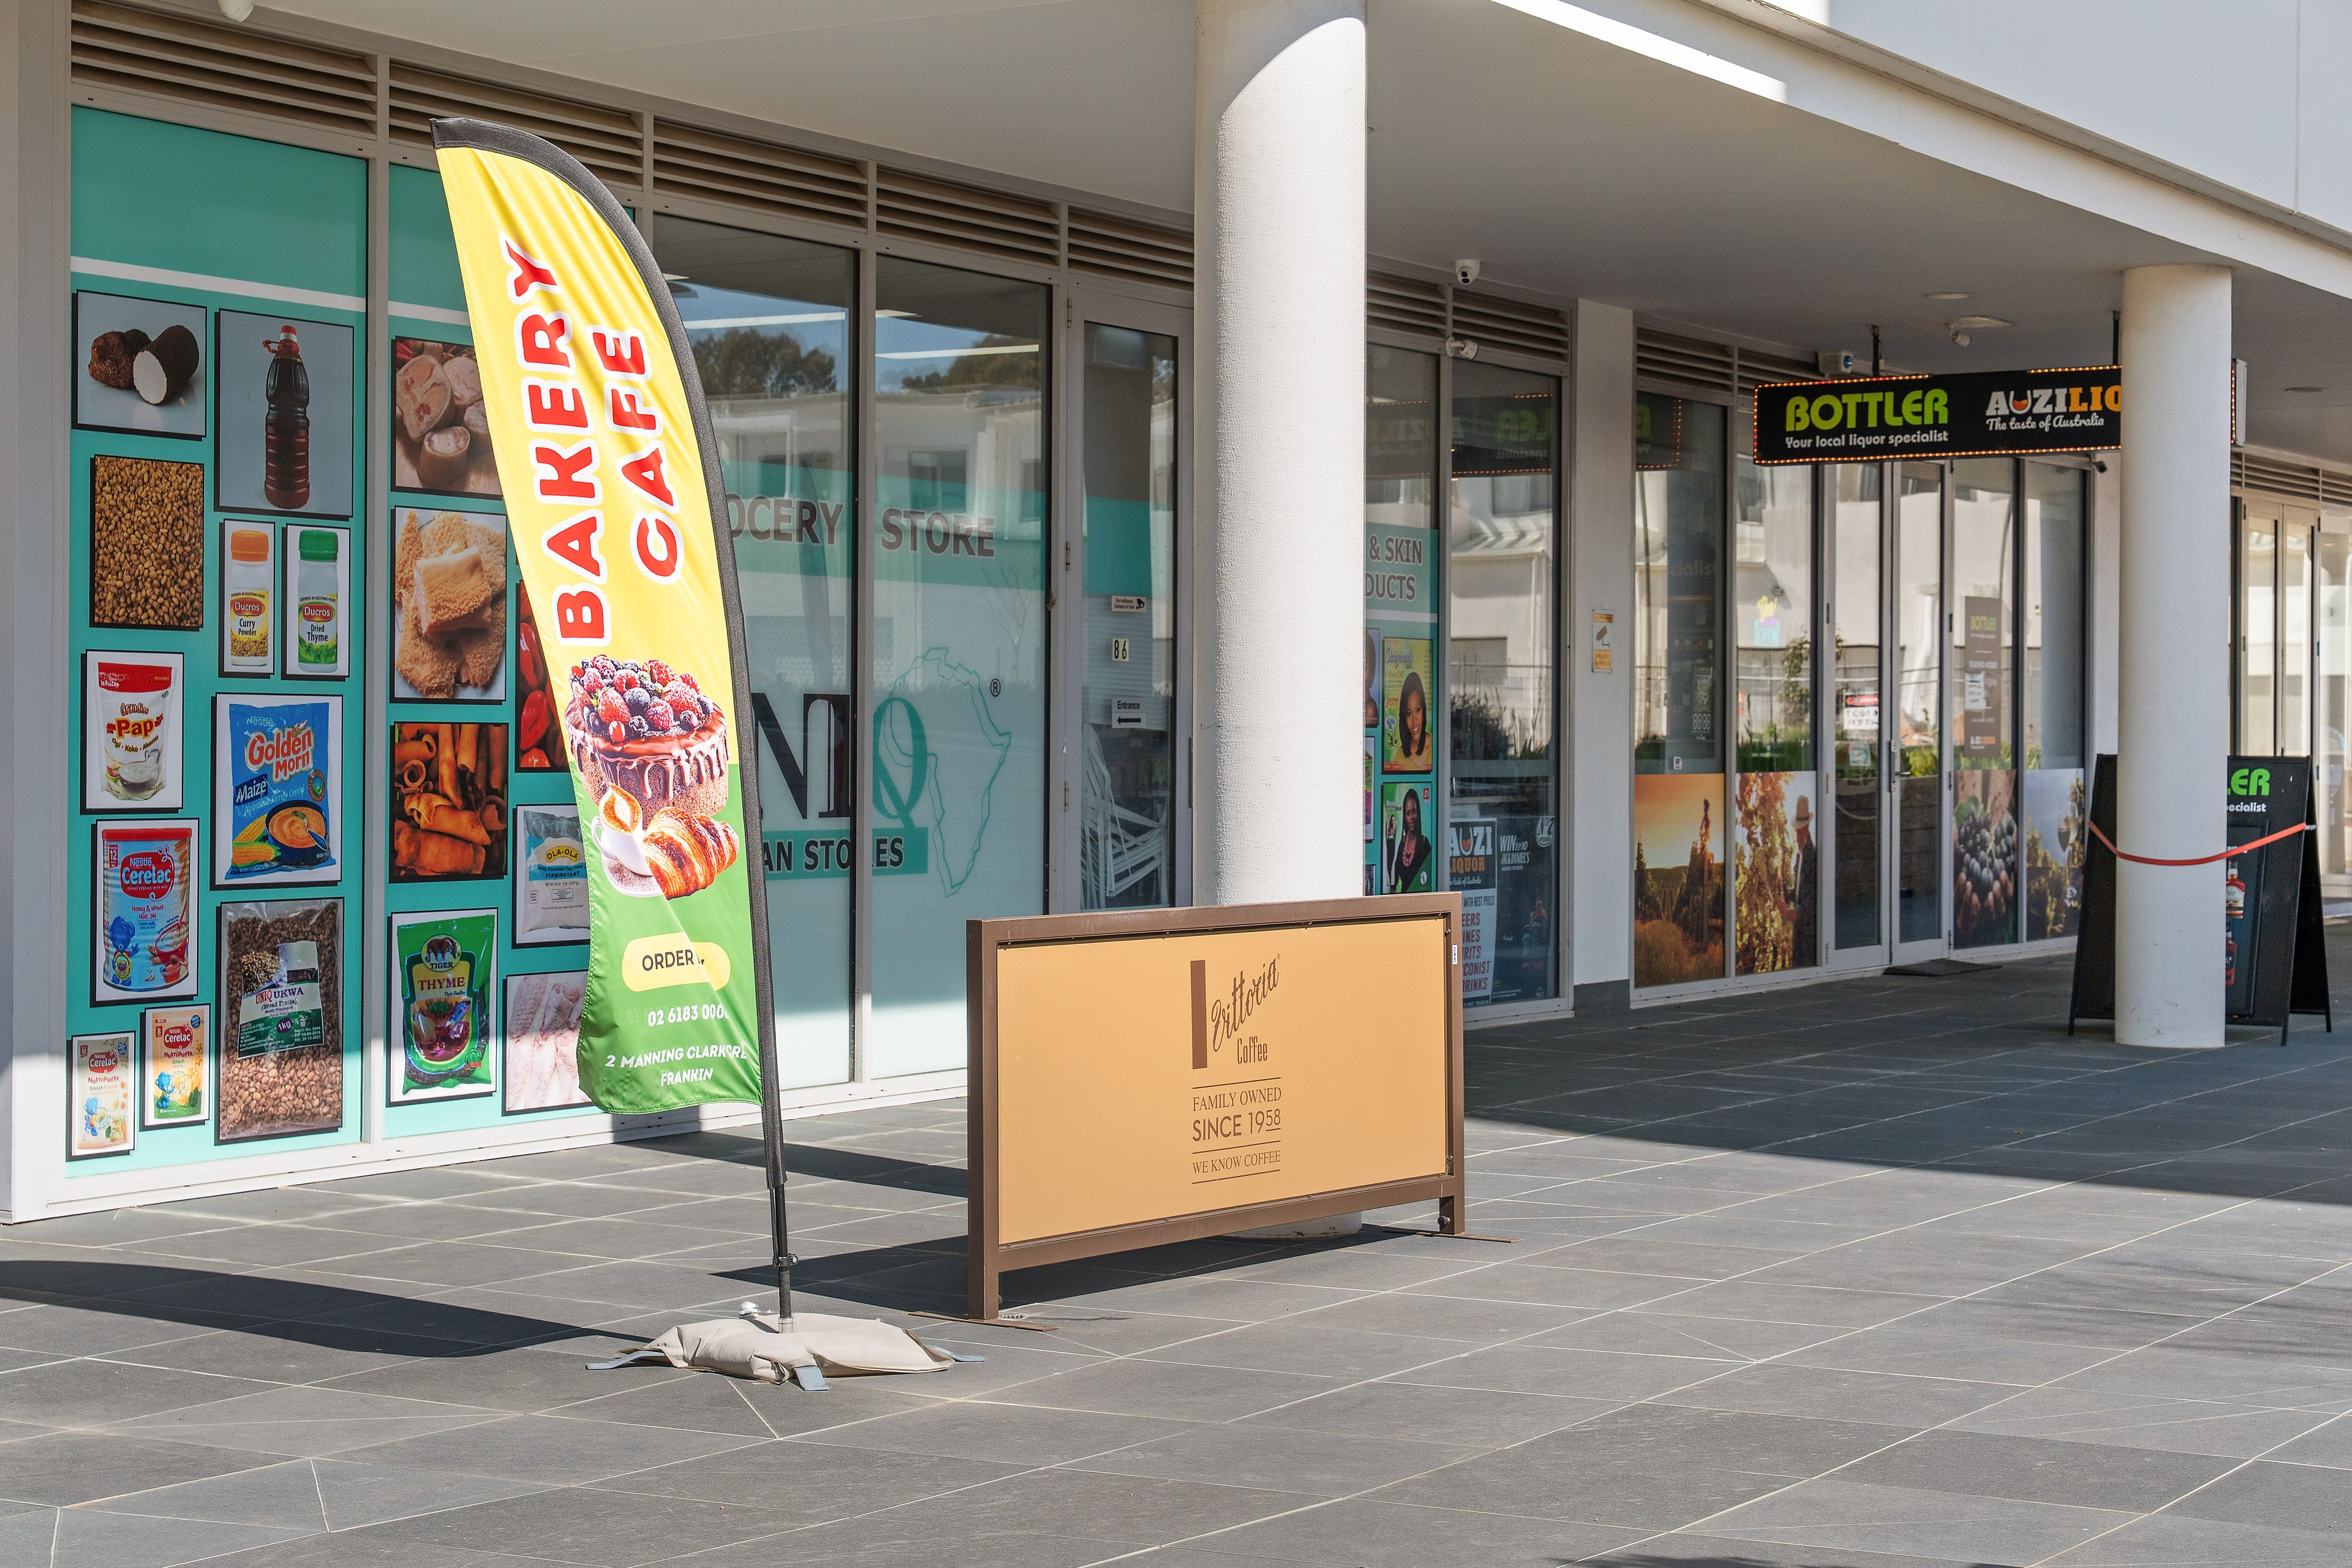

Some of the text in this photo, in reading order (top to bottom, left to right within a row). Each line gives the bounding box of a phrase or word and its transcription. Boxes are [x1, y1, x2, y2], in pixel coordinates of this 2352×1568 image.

[1785, 388, 1948, 432] BOTTLER
[1986, 412, 2105, 432] The taste of Australia
[500, 233, 611, 646] BAKERY
[1785, 430, 1949, 449] Your local liquor specialist
[587, 325, 684, 585] CAFE
[880, 507, 995, 558] STORE
[1369, 535, 1423, 565] & SKIN
[235, 601, 260, 611] Ducros
[304, 606, 331, 617] Ducros
[239, 618, 255, 630] Curry
[307, 632, 328, 644] Thyme
[1114, 639, 1127, 660] 86
[120, 703, 149, 716] Grandios
[1117, 701, 1140, 710] Entrance
[116, 718, 154, 738] Pap
[112, 738, 121, 748] Ogi
[143, 735, 159, 750] Akamu
[248, 729, 312, 766] Golden
[274, 750, 310, 779] Morn
[235, 780, 266, 804] Maize
[2228, 801, 2267, 813] ecialist
[1500, 835, 1517, 852] WIN
[110, 850, 117, 861] 12
[547, 848, 578, 859] OLA-OLA
[804, 837, 905, 871] STOES
[123, 867, 171, 885] Cerelac
[131, 905, 146, 914] Honey
[642, 949, 695, 971] ORDER
[417, 976, 466, 991] THYME
[255, 987, 304, 1005] UNIQ UKWA
[1211, 958, 1280, 1052] Vittoria
[277, 1021, 292, 1030] 1kg
[647, 1009, 665, 1027] 02
[668, 1005, 699, 1023] 6183
[164, 1033, 191, 1043] Cerelac
[605, 1054, 617, 1068] 2
[619, 1047, 684, 1068] MANNING
[1237, 1035, 1268, 1065] Coffee
[89, 1058, 116, 1068] Cerelac
[660, 1068, 714, 1087] FRANKIN
[1192, 1087, 1282, 1112] FAMILY OWNED
[1192, 1108, 1281, 1142] SINCE 1958
[1192, 1150, 1281, 1174] WE KNOW COFFEE
